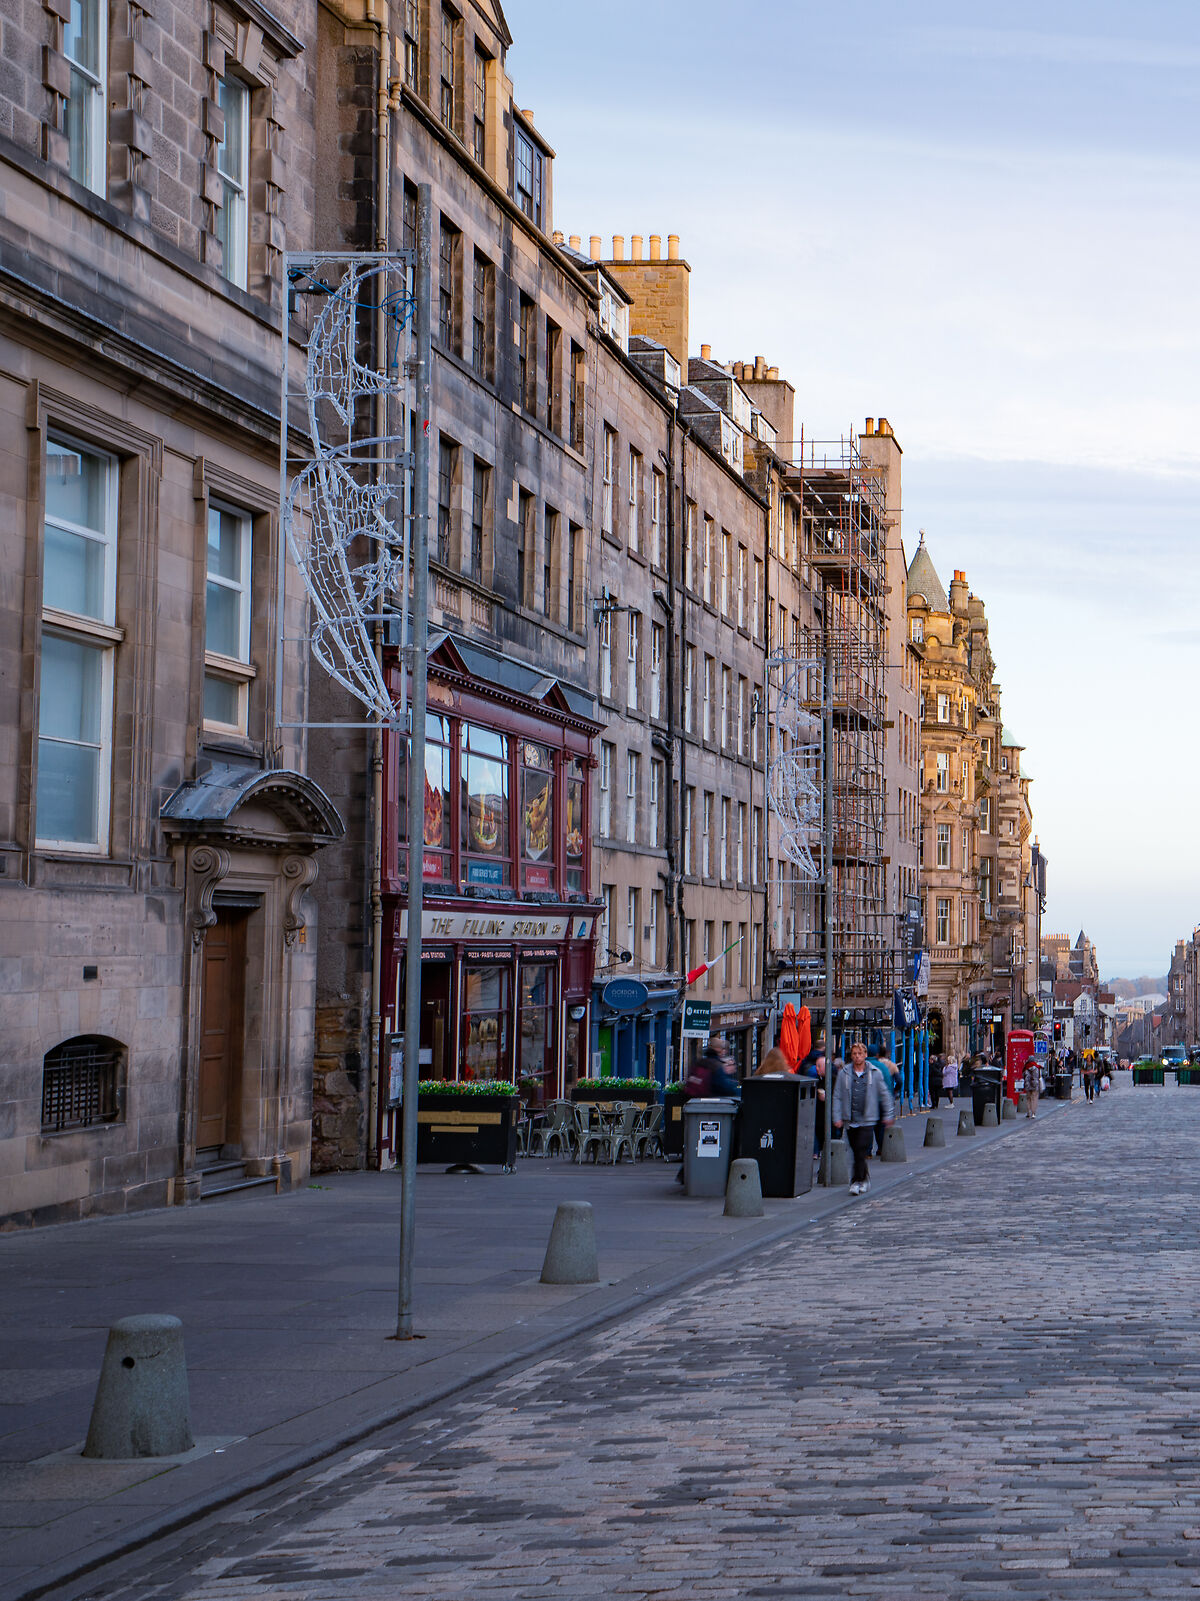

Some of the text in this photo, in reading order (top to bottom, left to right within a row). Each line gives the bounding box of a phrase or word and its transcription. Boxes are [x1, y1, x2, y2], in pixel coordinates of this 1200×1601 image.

[431, 917, 454, 936] THE
[463, 918, 505, 937] FILLING
[511, 921, 549, 937] STATION
